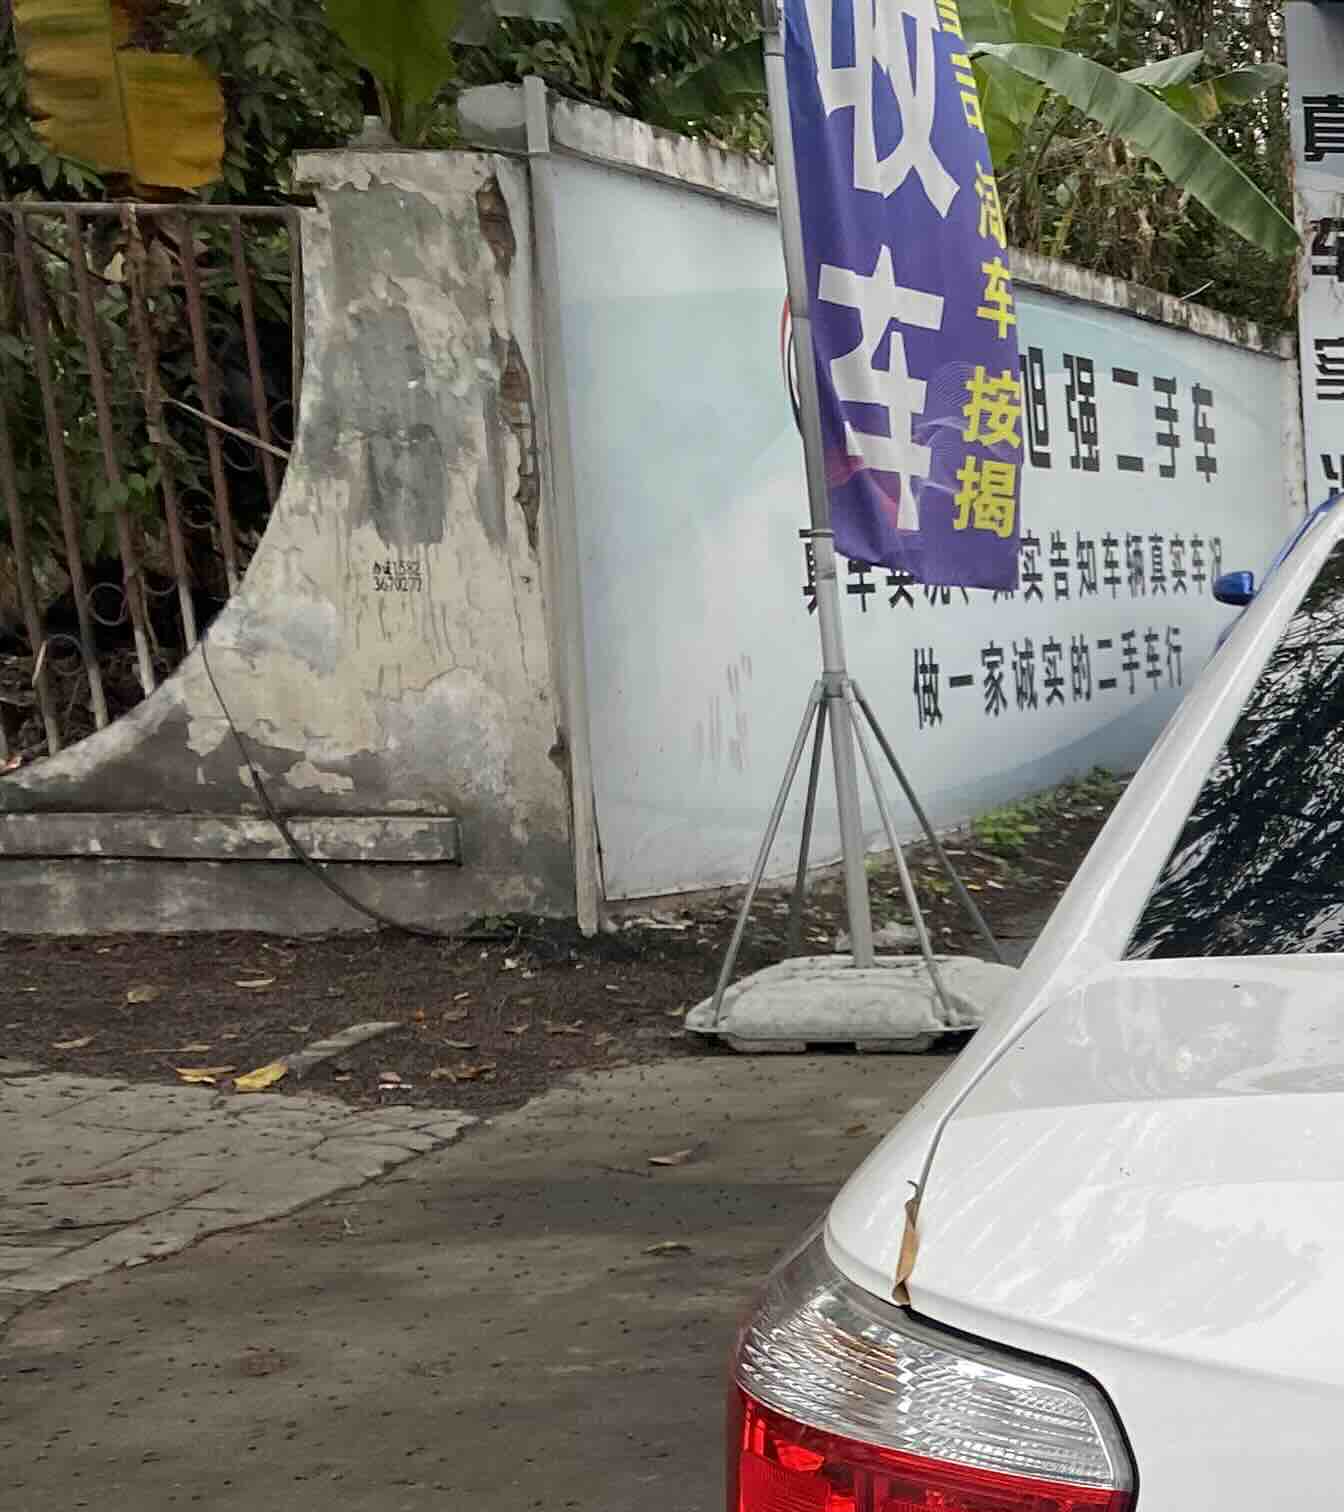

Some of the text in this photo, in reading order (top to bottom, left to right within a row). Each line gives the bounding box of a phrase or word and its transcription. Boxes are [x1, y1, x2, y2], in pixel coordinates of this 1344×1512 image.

[913, 625, 1184, 730] 做一家诚实的二手车行
